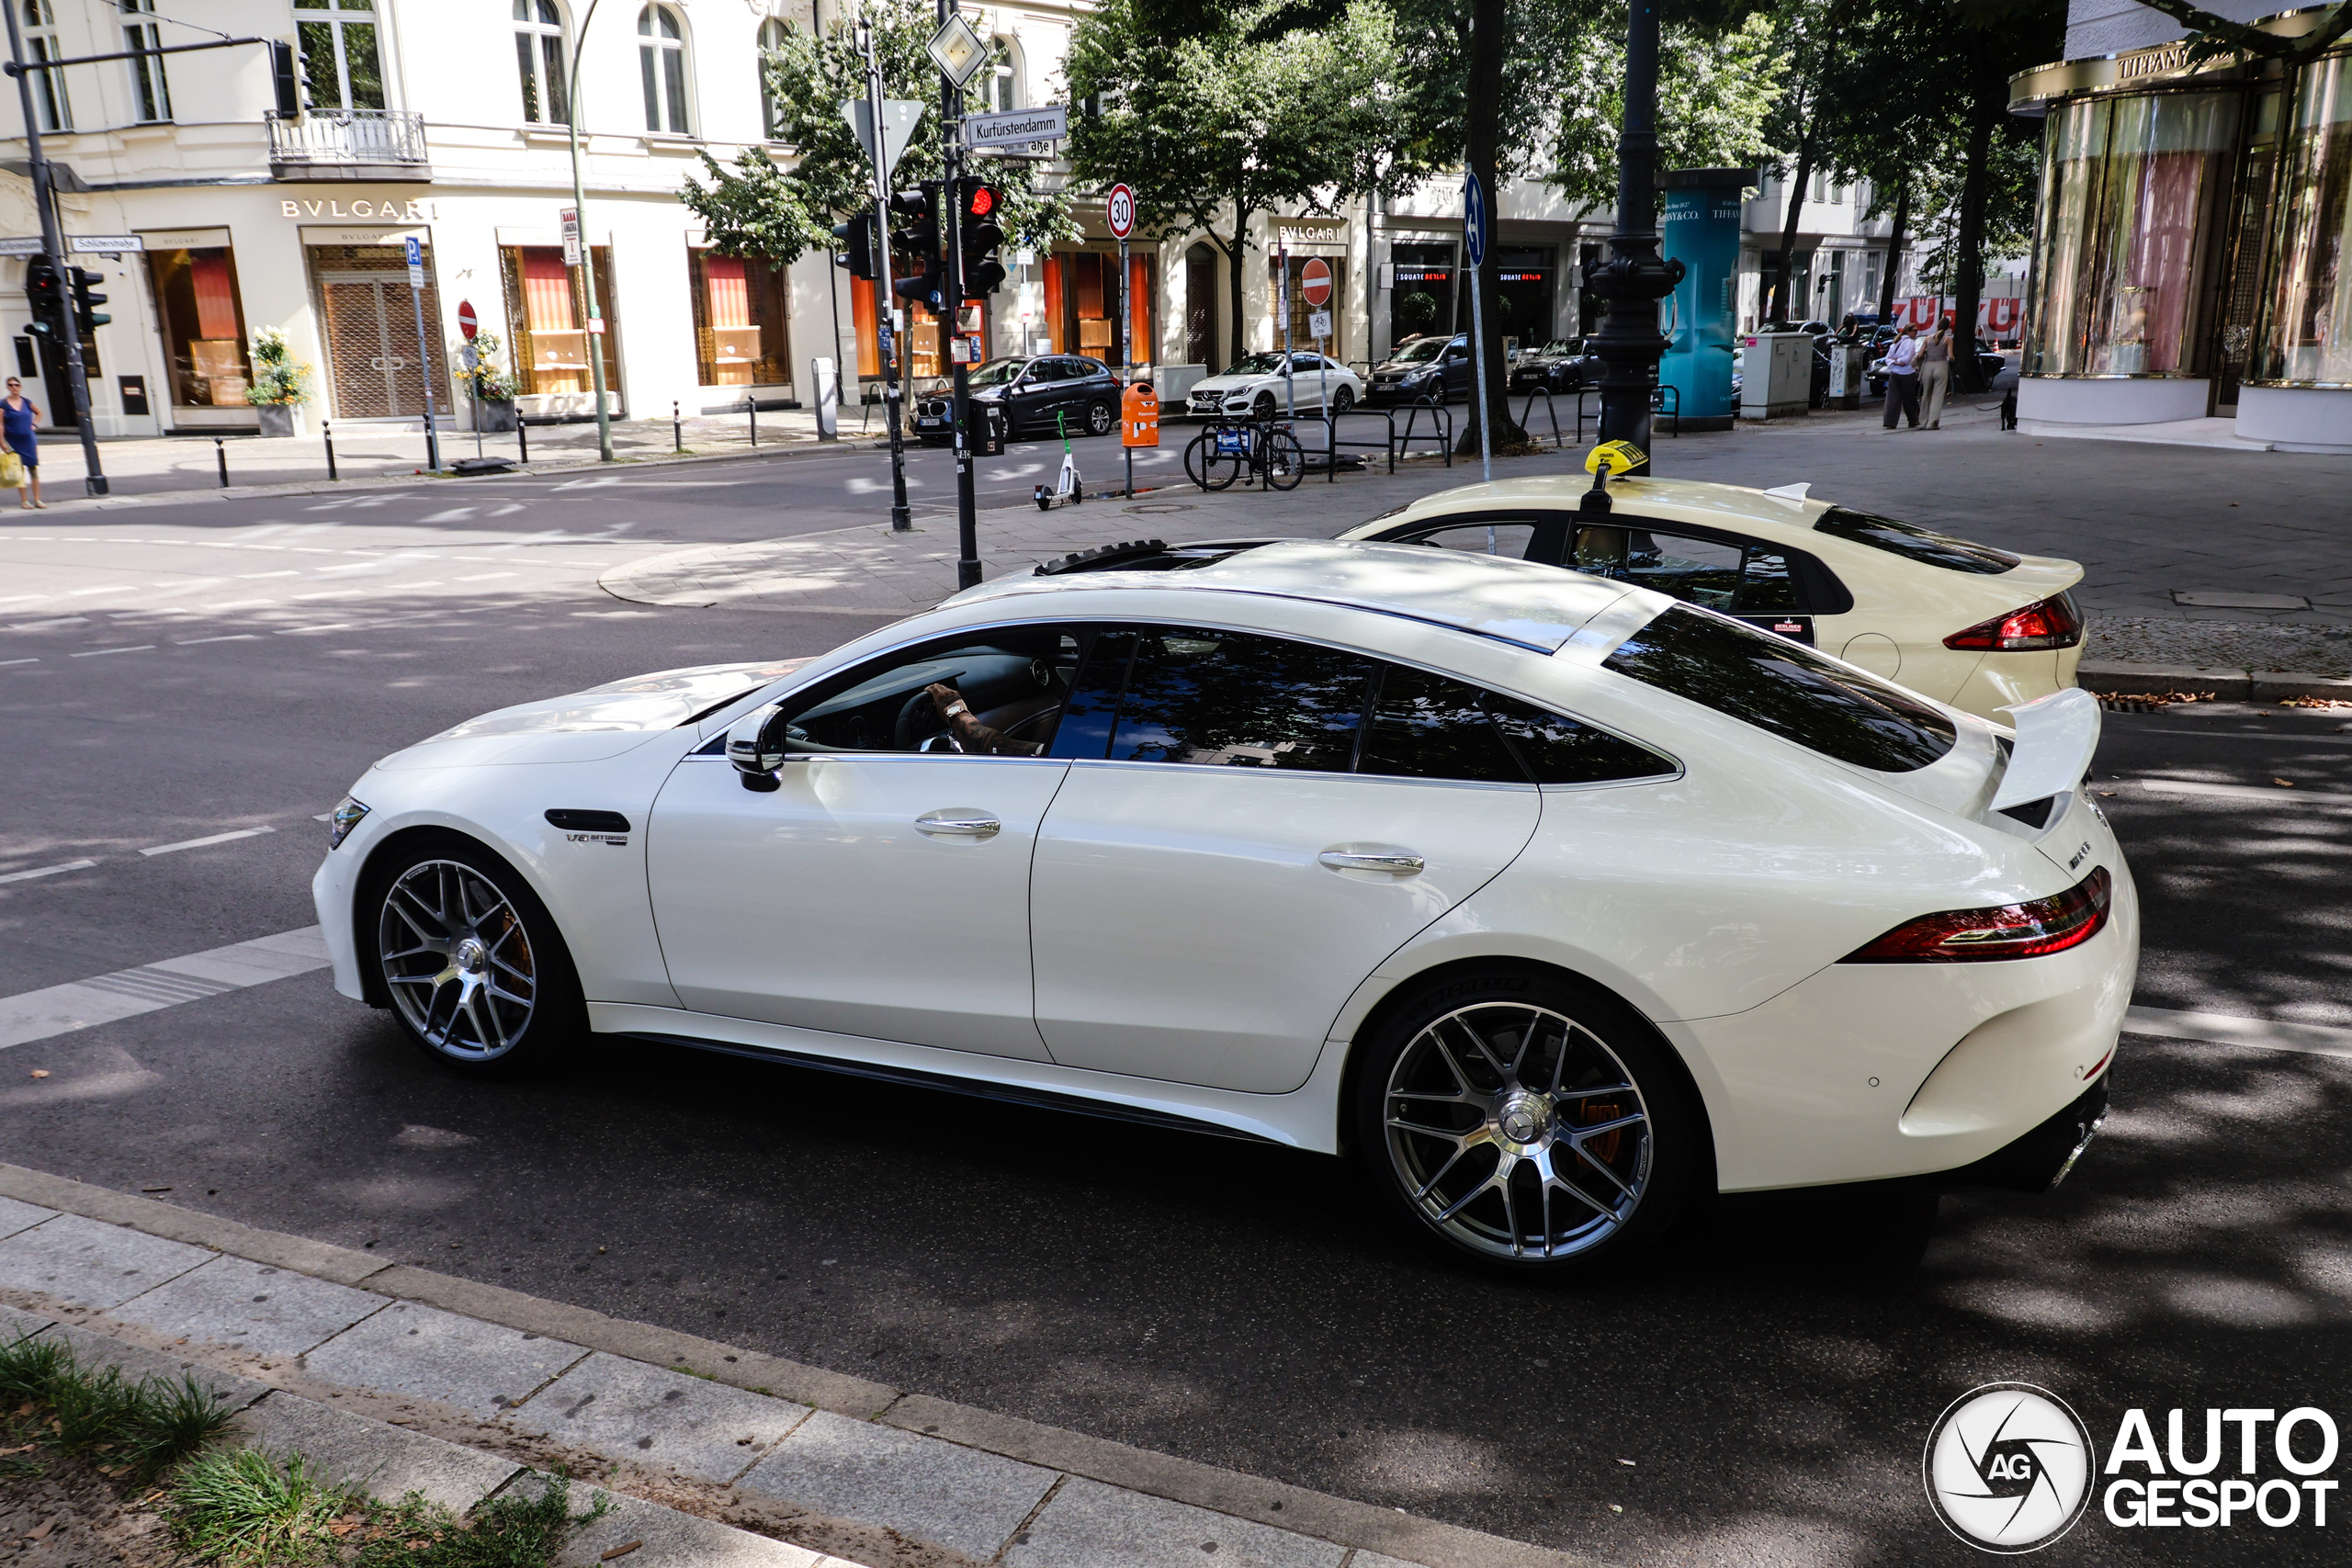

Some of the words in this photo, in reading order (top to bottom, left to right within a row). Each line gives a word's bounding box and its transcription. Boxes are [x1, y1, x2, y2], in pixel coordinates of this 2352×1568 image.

[977, 118, 1056, 139] Kurfürstendamm
[279, 199, 439, 220] BVLGARI
[562, 212, 576, 222] BABA
[1113, 199, 1128, 222] 30
[1279, 226, 1340, 241] BVLGARI
[1427, 978, 1524, 1008] MICHELIN
